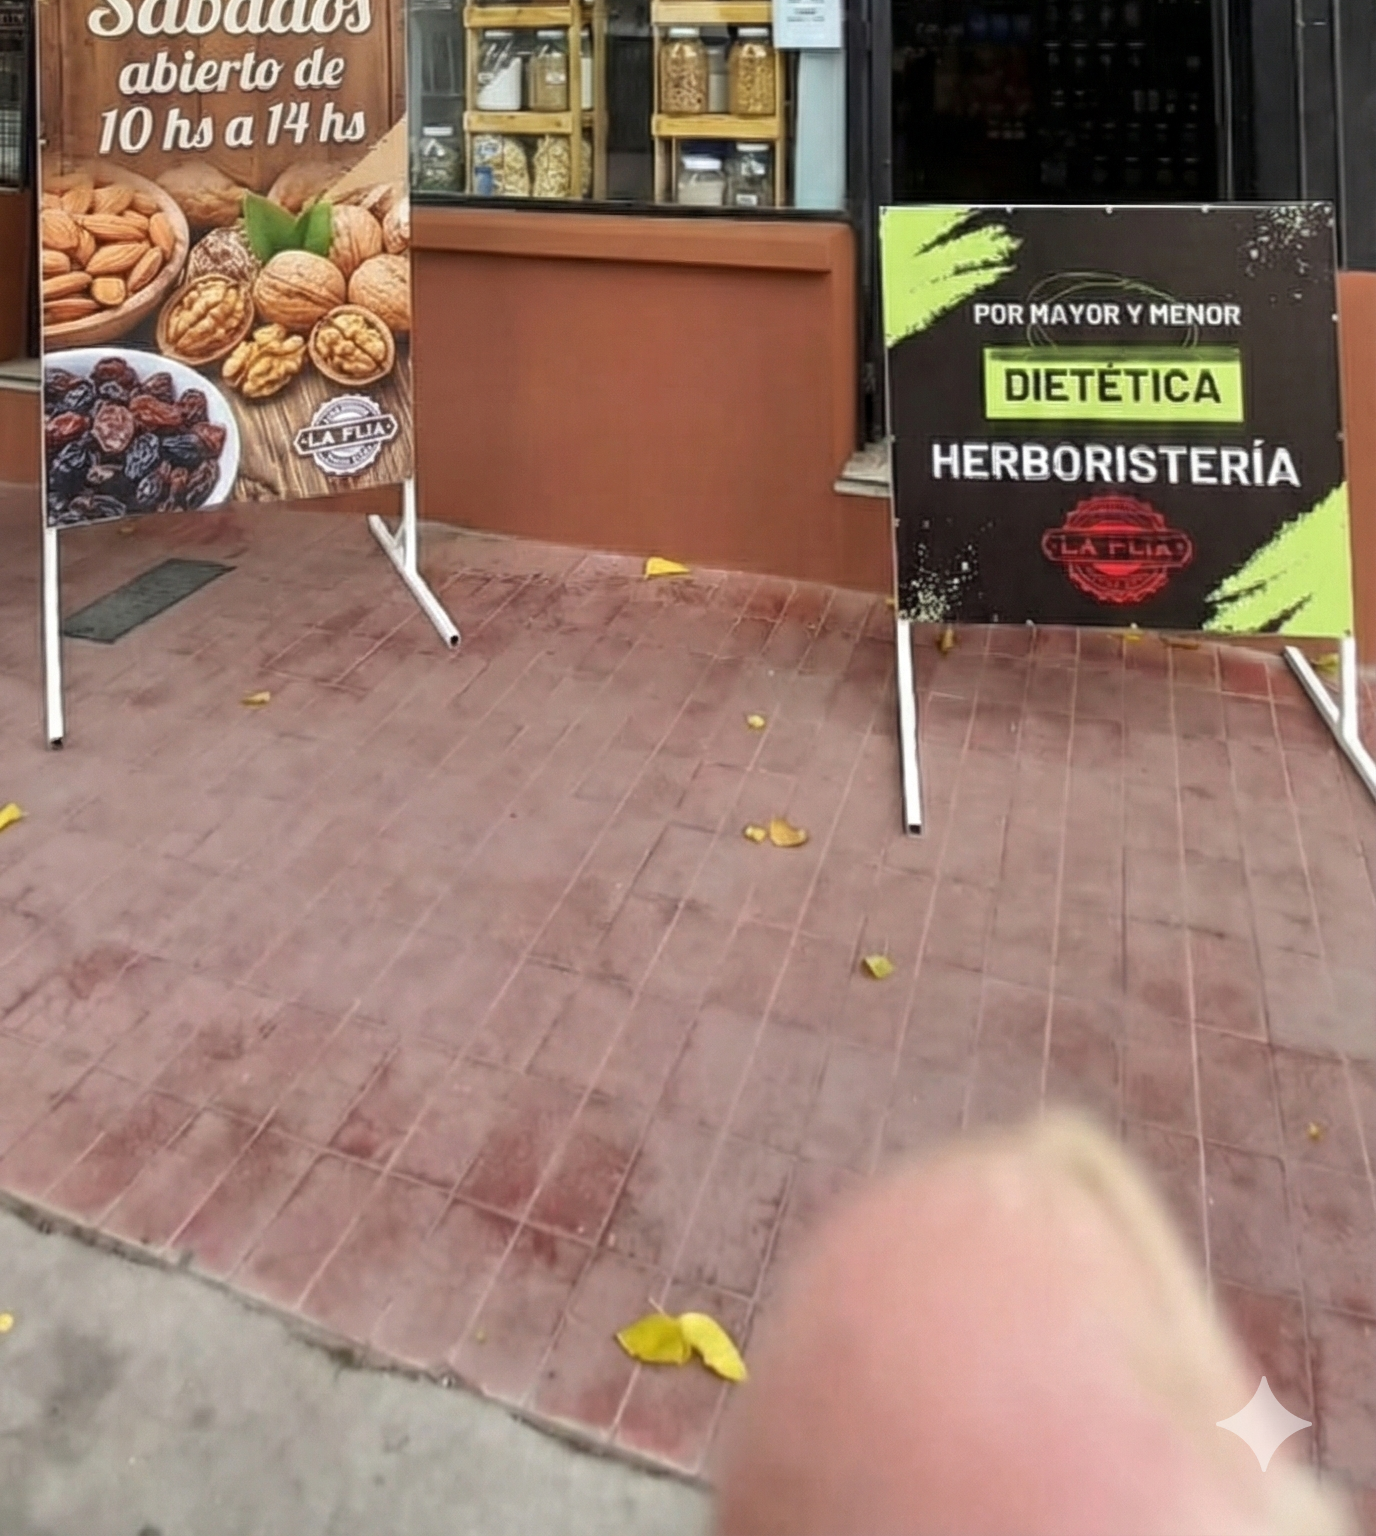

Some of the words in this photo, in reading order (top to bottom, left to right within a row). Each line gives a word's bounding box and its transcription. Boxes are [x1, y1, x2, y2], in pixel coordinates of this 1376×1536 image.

[118, 50, 285, 95] abierto
[294, 47, 345, 90] de
[100, 106, 152, 154] 10
[162, 108, 214, 151] hs
[224, 113, 254, 147] a
[267, 101, 309, 145] 14
[320, 101, 365, 143] hs
[973, 303, 1024, 325] POR
[1030, 304, 1120, 325] MAYOR
[1126, 304, 1143, 324] Y
[1151, 304, 1241, 326] MENOR
[1005, 361, 1221, 404] DIETÉTICA
[308, 430, 335, 448] LA
[342, 422, 385, 441] FLIA
[932, 439, 1300, 488] HERBORISTERÍA
[1061, 535, 1097, 555] LA
